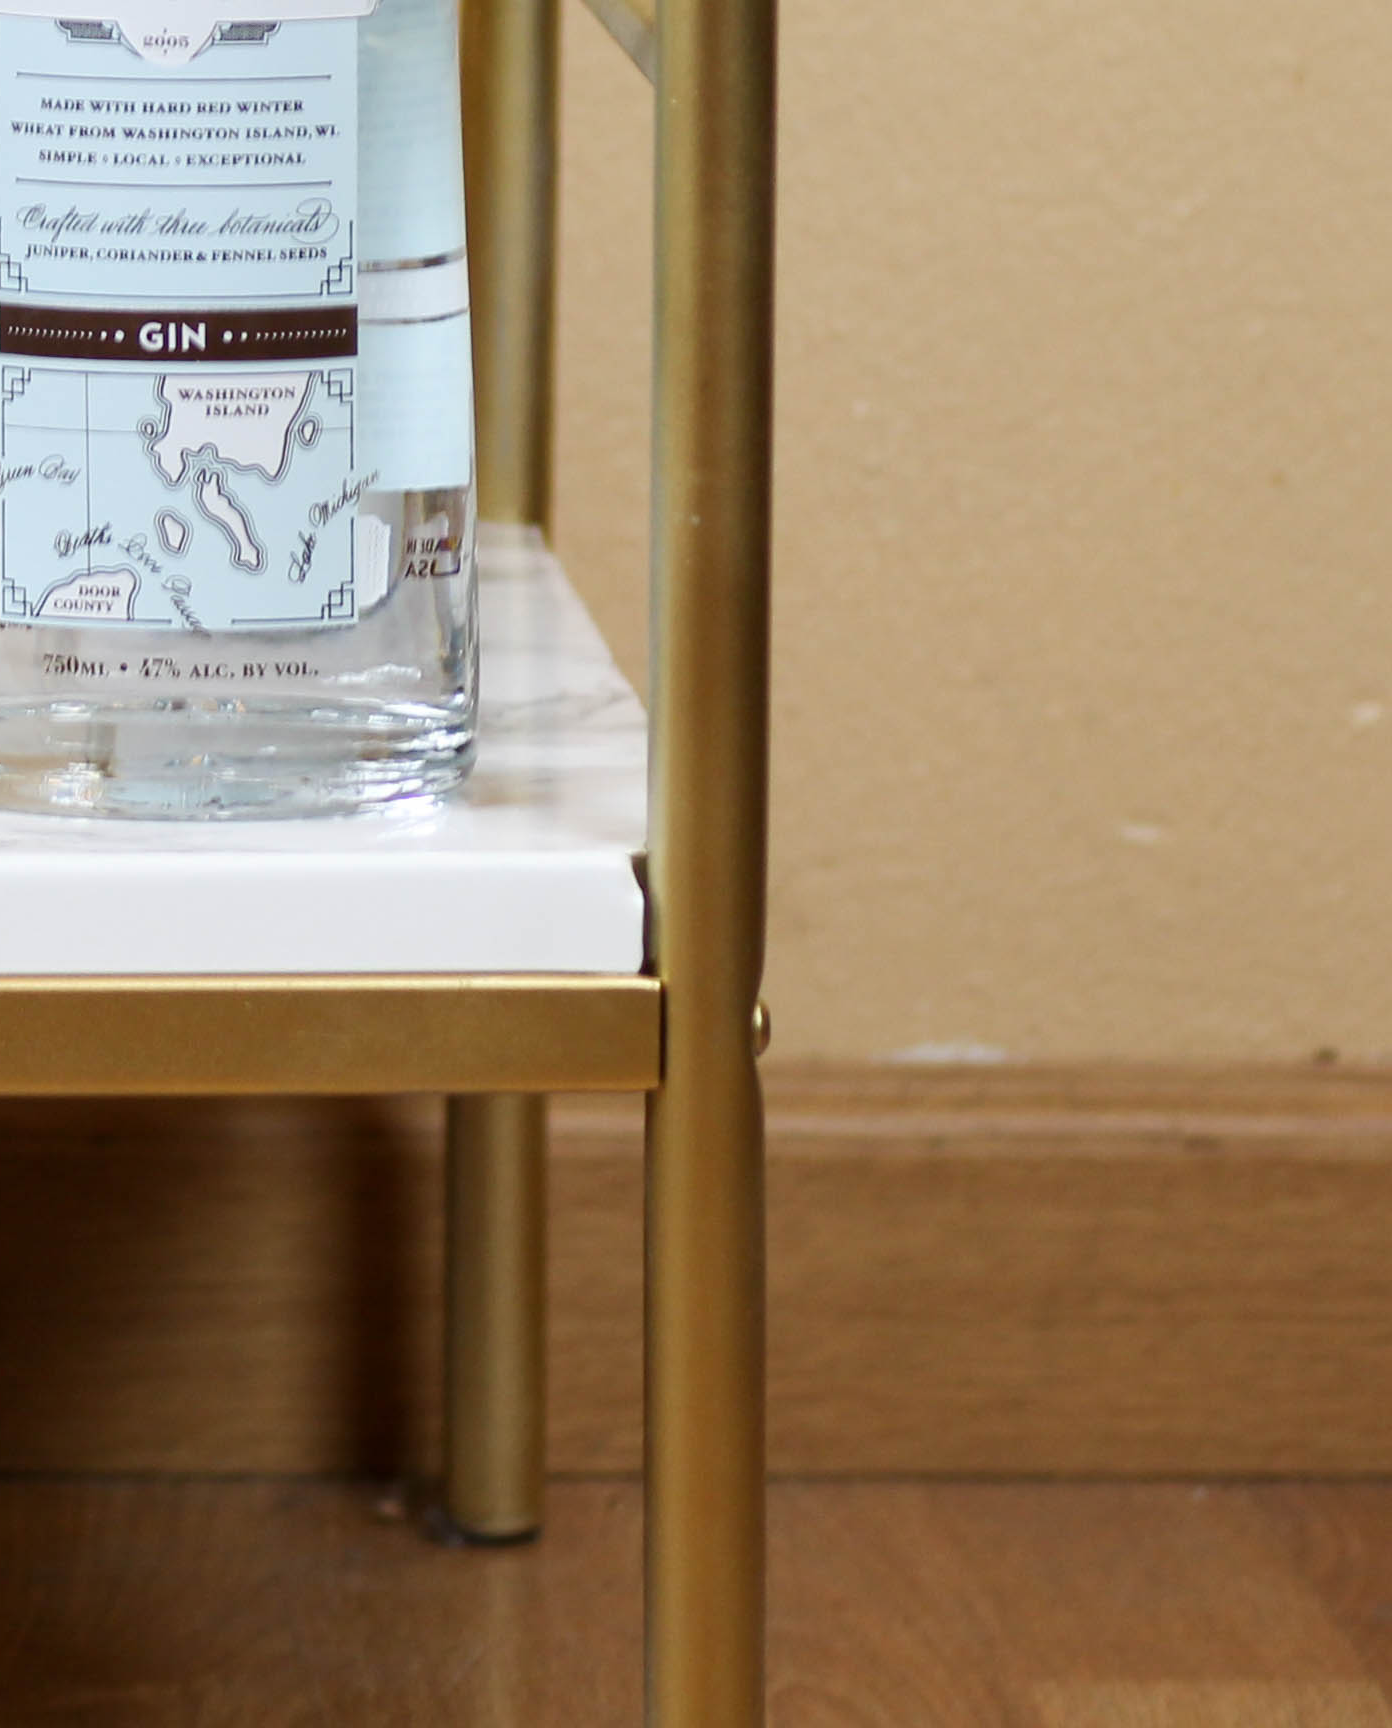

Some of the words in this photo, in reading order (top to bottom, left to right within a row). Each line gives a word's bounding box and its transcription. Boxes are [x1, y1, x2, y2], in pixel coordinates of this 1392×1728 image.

[40, 97, 86, 114] MADE
[89, 99, 136, 114] WITH
[143, 100, 191, 114] HARD
[197, 100, 232, 114] RED
[237, 99, 305, 113] WINTER
[10, 121, 63, 138] WHEAT
[68, 124, 116, 140] FROM
[122, 127, 240, 140] WASHINGTON
[38, 149, 97, 165] SIMPLE
[113, 152, 170, 167] LOCAL
[186, 152, 307, 166] EXCEPTIONAL
[17, 201, 102, 252] Crafted
[100, 212, 150, 237] with
[150, 213, 209, 237] three
[208, 197, 340, 245] botanicals
[96, 247, 194, 262] CORIANDER
[195, 247, 208, 262] &
[211, 247, 277, 262] FENNEL
[279, 245, 328, 260] SEEDS
[137, 321, 208, 354] GIN
[177, 384, 297, 401] WASHINGTON
[204, 403, 270, 418] ISLAND
[77, 584, 121, 598] DOOR
[53, 598, 116, 612] COUNTY
[138, 656, 182, 679] 47%
[242, 663, 268, 678] BY
